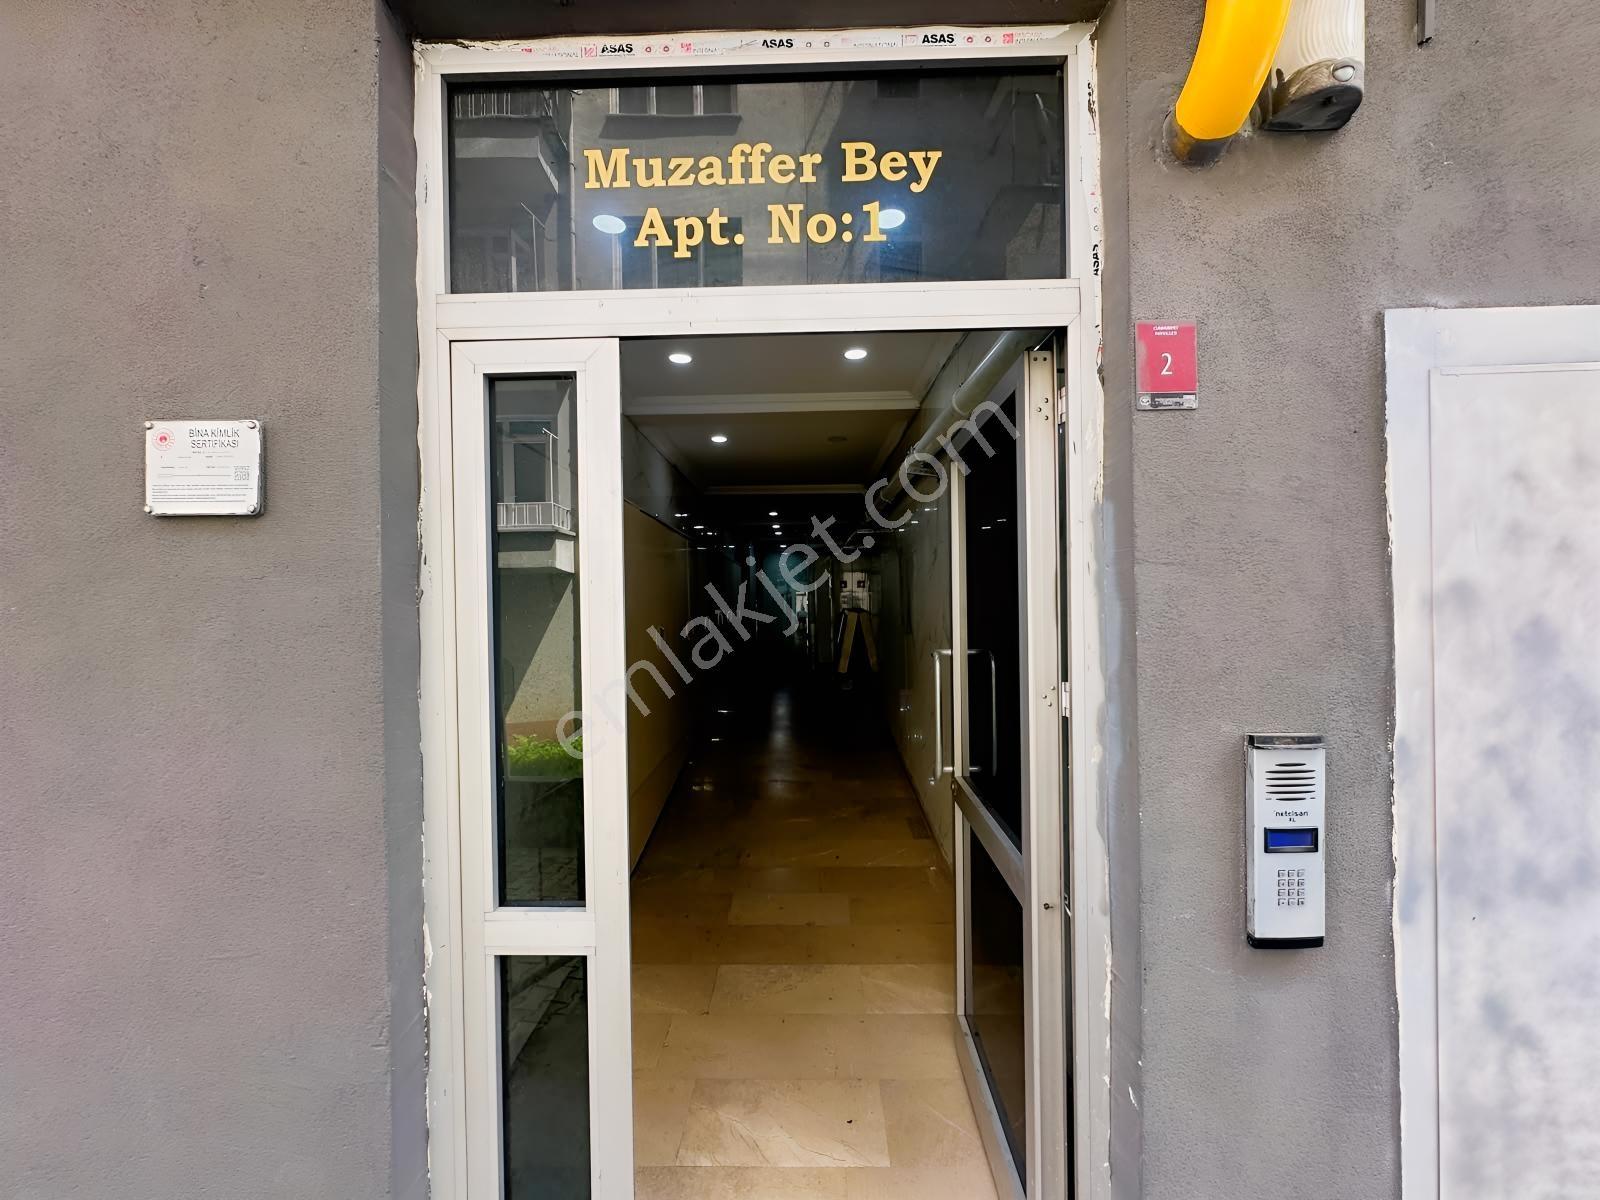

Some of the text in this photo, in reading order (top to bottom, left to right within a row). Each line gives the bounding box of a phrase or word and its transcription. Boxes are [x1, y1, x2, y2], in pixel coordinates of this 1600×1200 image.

[601, 43, 633, 54] ASAS
[922, 34, 954, 44] ASAS
[584, 141, 943, 193] Muzaffer Bey
[633, 200, 888, 259] Apt. No:1
[1161, 352, 1172, 375] 2
